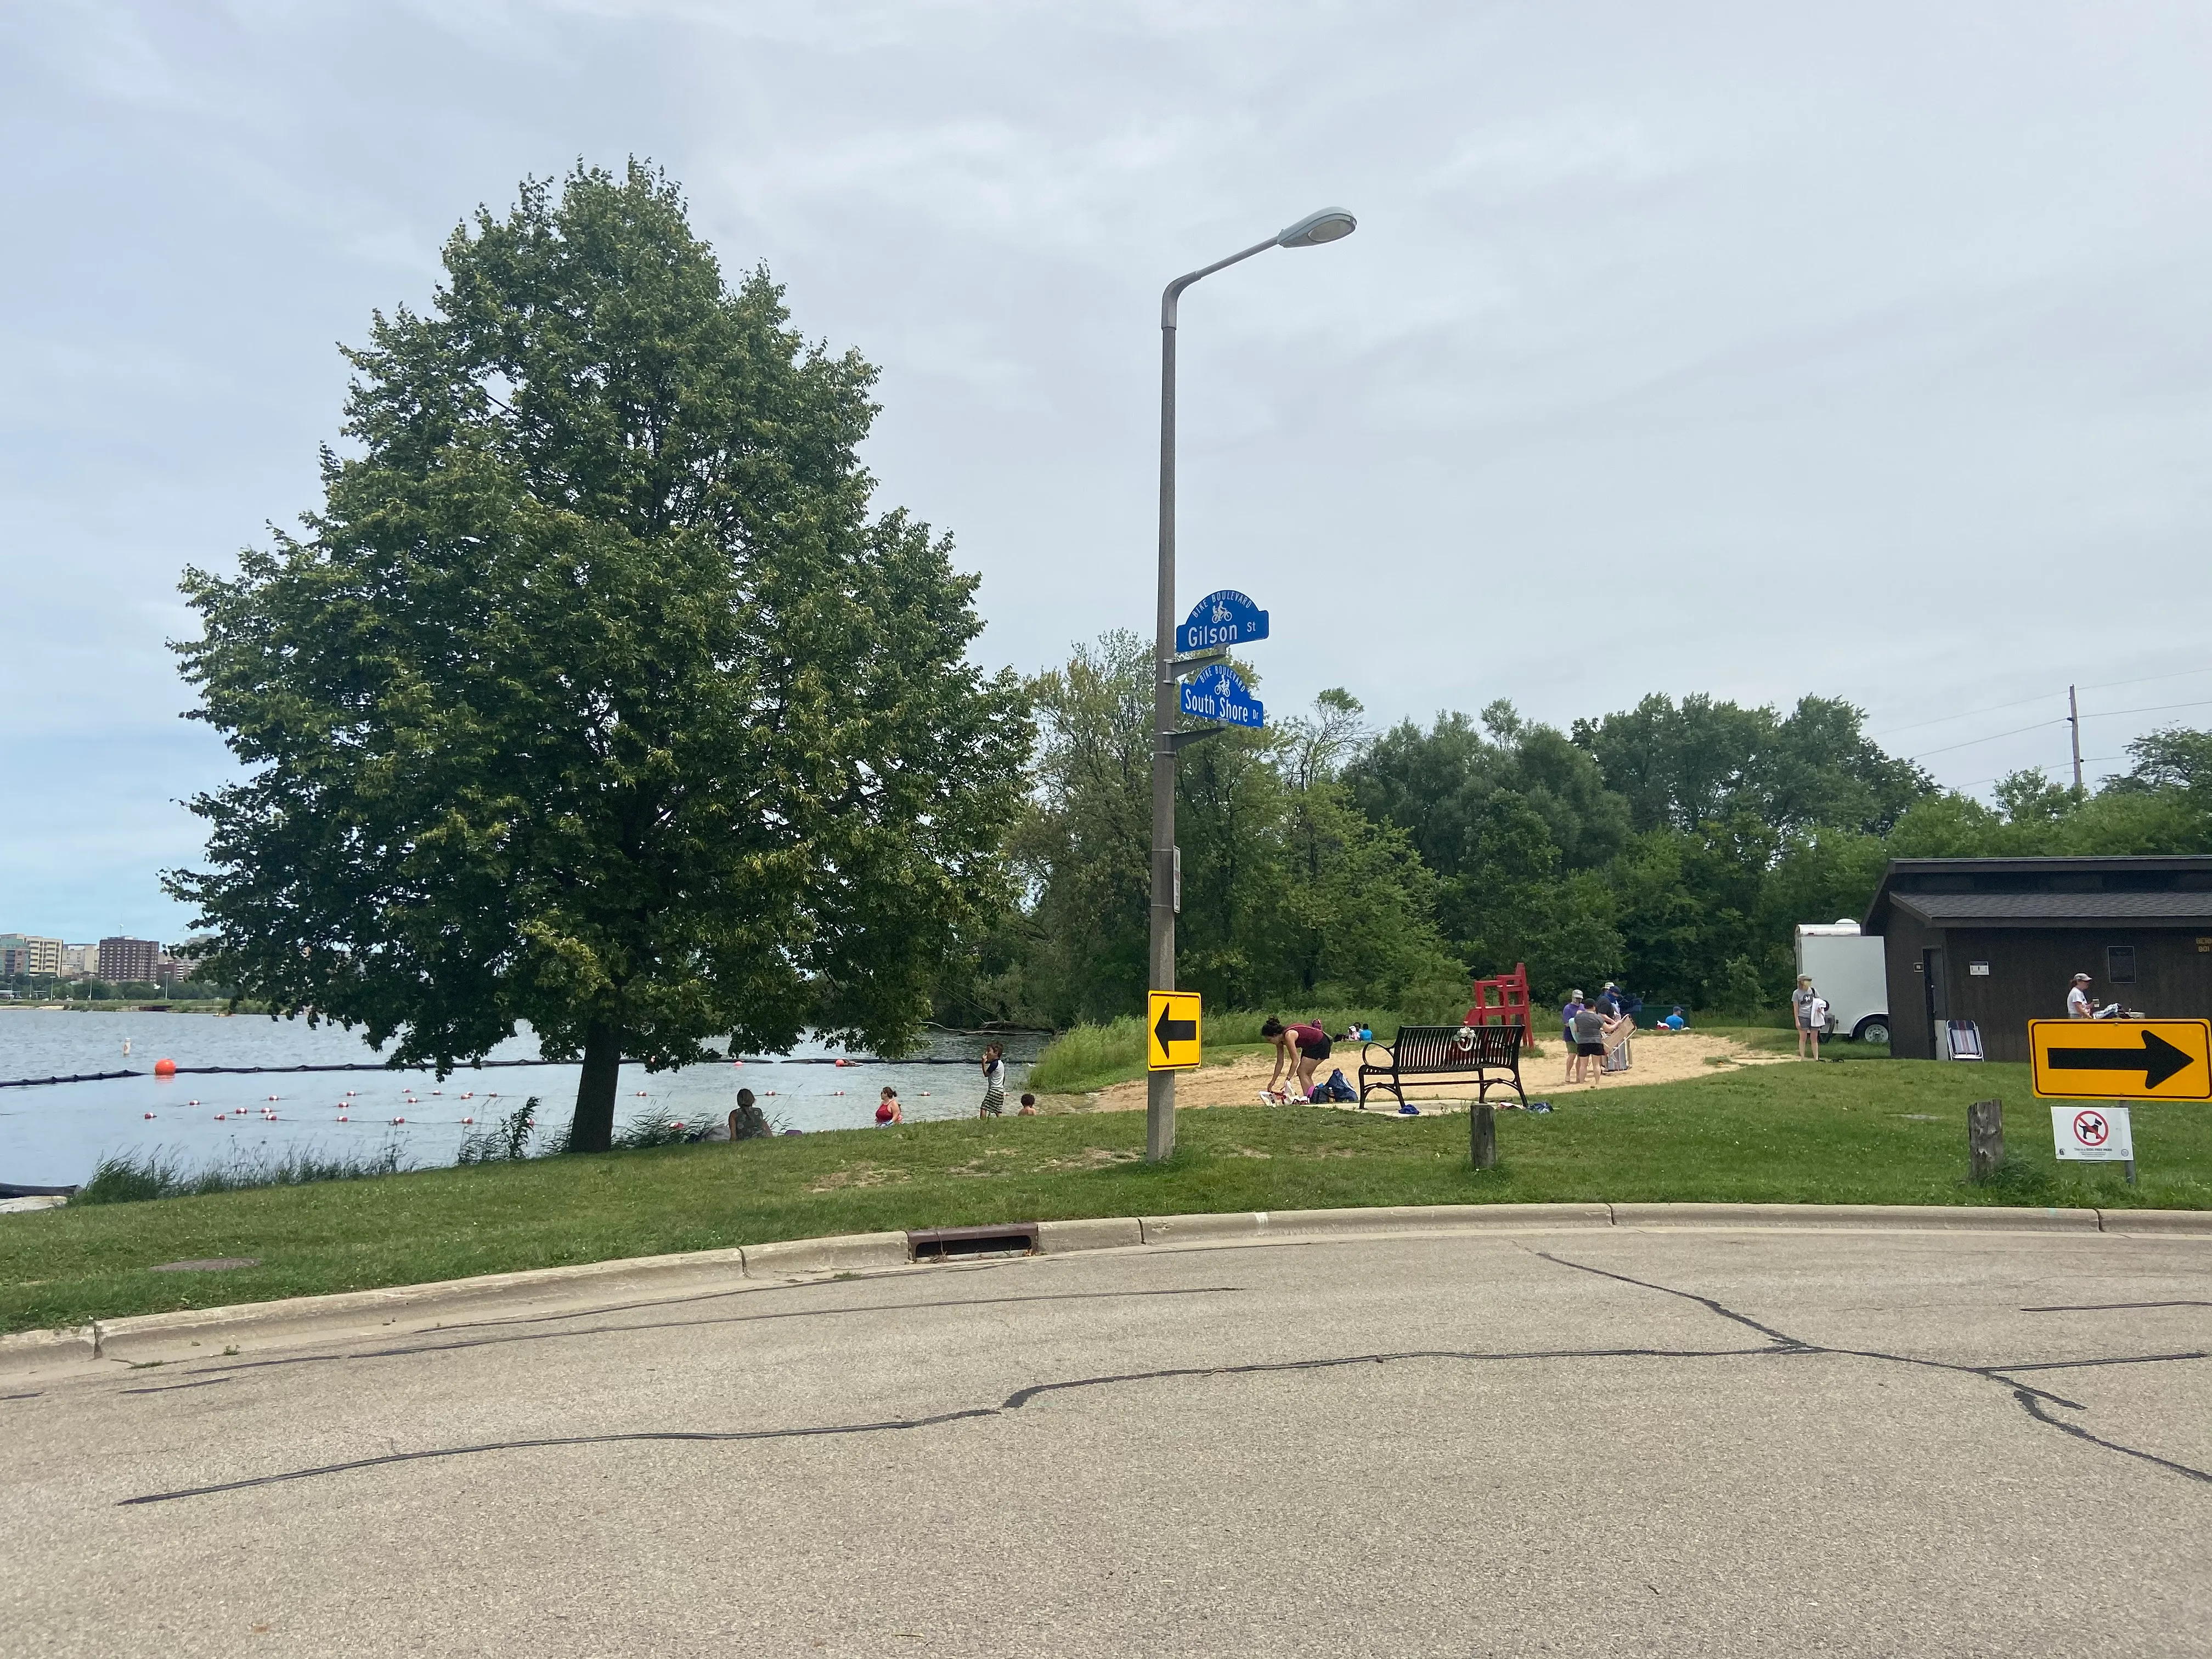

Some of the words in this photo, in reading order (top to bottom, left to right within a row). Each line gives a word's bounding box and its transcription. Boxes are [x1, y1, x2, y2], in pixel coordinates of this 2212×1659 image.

[1192, 599, 1208, 618] BIKE
[1211, 591, 1252, 608] BOULEVARD
[1188, 624, 1237, 647] Gilson
[1246, 621, 1256, 633] St
[1199, 667, 1212, 684] BIKE
[1215, 665, 1245, 692] BOULEVARD
[1185, 689, 1215, 715] South
[1220, 697, 1248, 723] Shore
[1252, 709, 1259, 720] Dr
